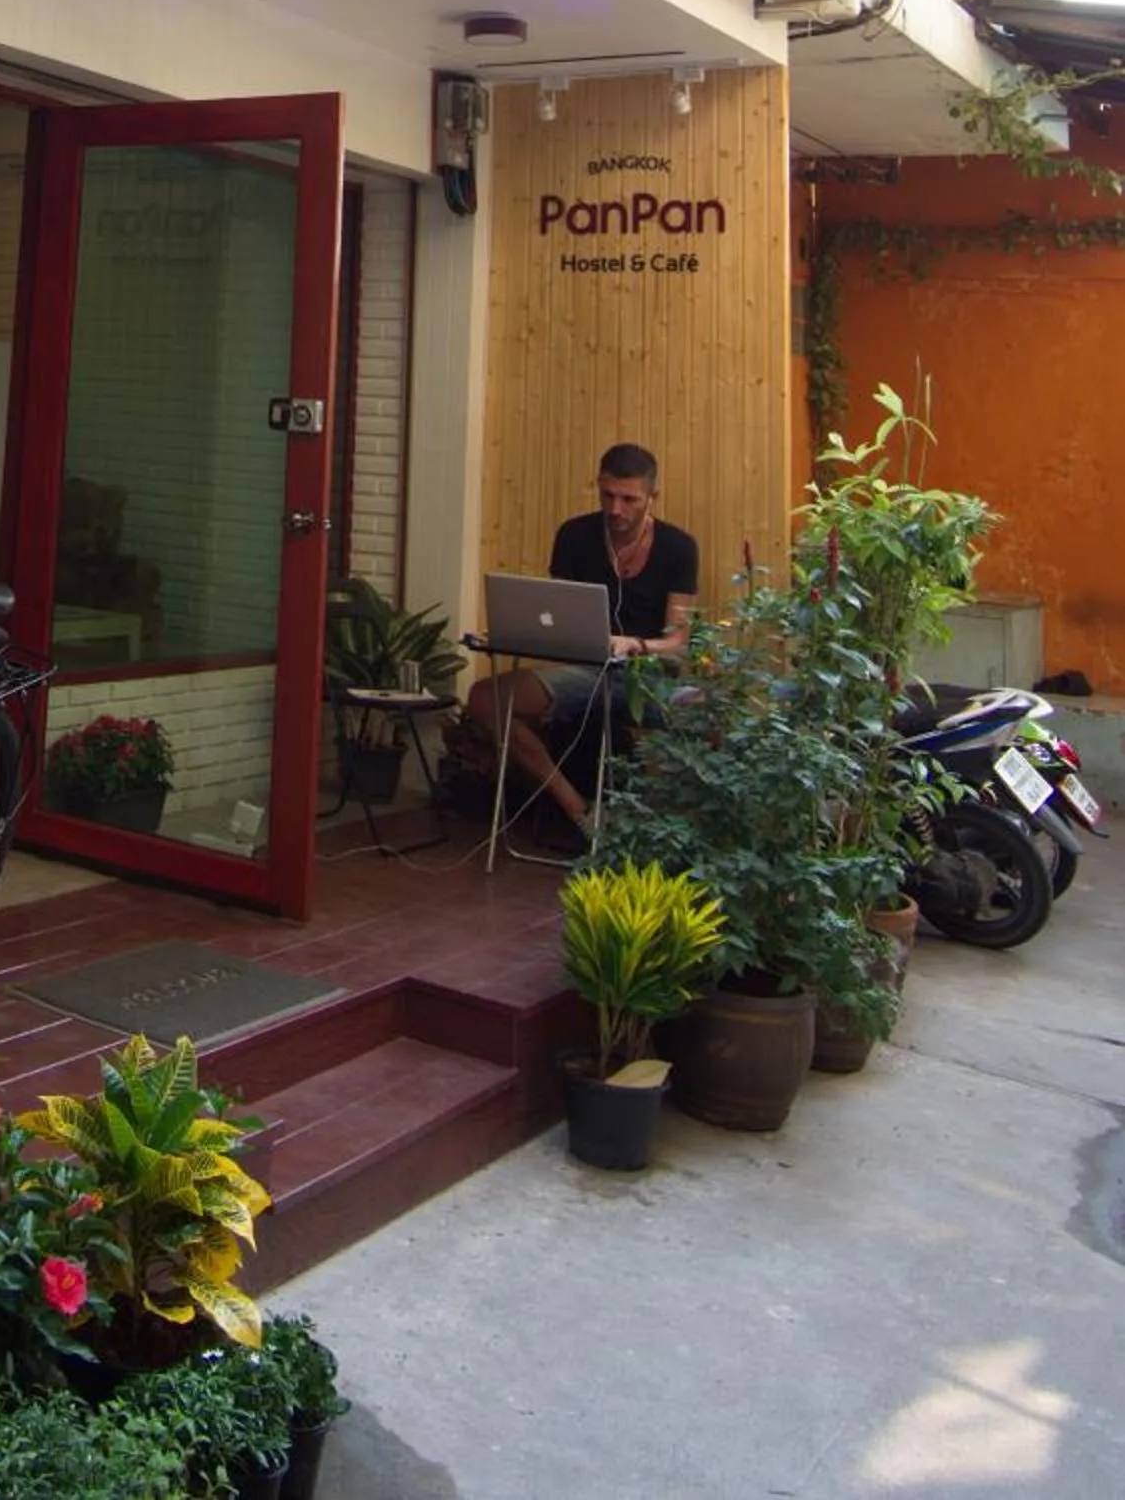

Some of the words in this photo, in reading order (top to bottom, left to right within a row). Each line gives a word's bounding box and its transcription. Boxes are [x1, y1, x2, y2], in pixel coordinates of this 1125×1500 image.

[587, 155, 672, 175] BANGKOK
[539, 193, 725, 235] PanPan
[561, 253, 625, 273] Hostel
[630, 254, 645, 273] &
[650, 253, 699, 273] Café
